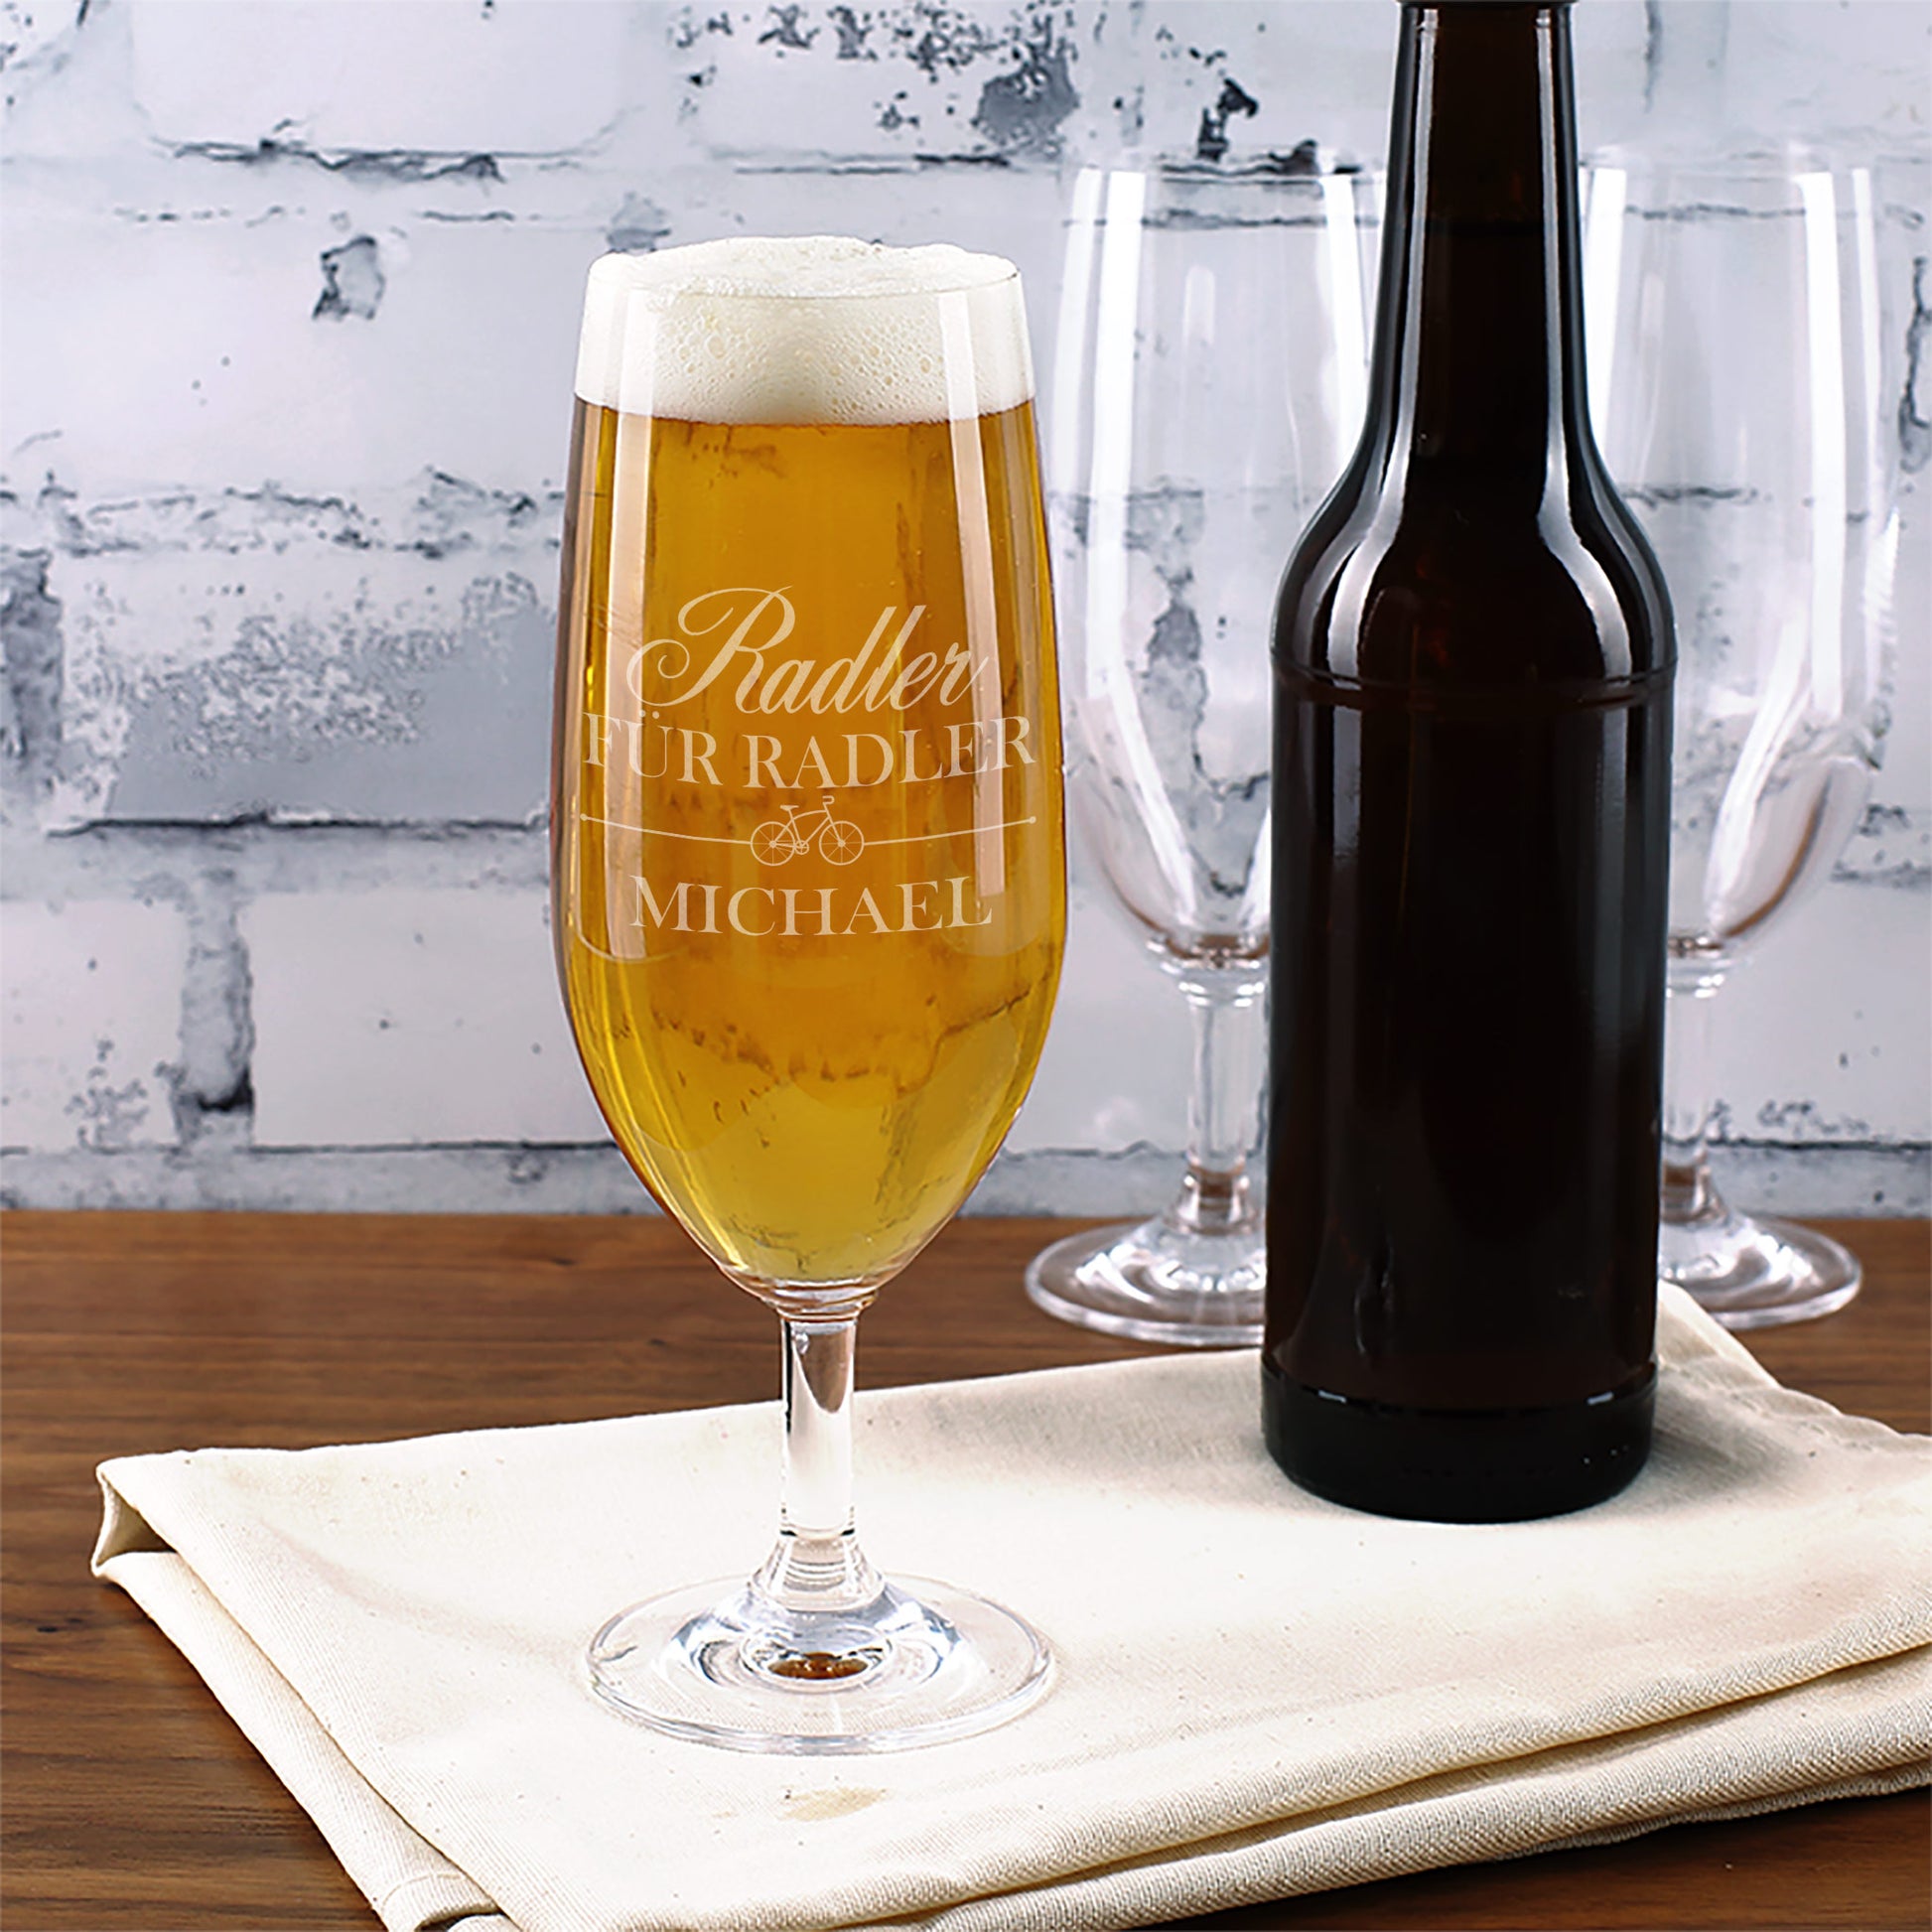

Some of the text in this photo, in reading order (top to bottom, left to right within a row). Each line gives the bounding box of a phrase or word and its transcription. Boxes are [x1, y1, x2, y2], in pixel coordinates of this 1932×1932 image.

[626, 586, 989, 715] Radler
[583, 711, 1037, 789] FÜR RADLER
[628, 875, 992, 936] MICHAEL
